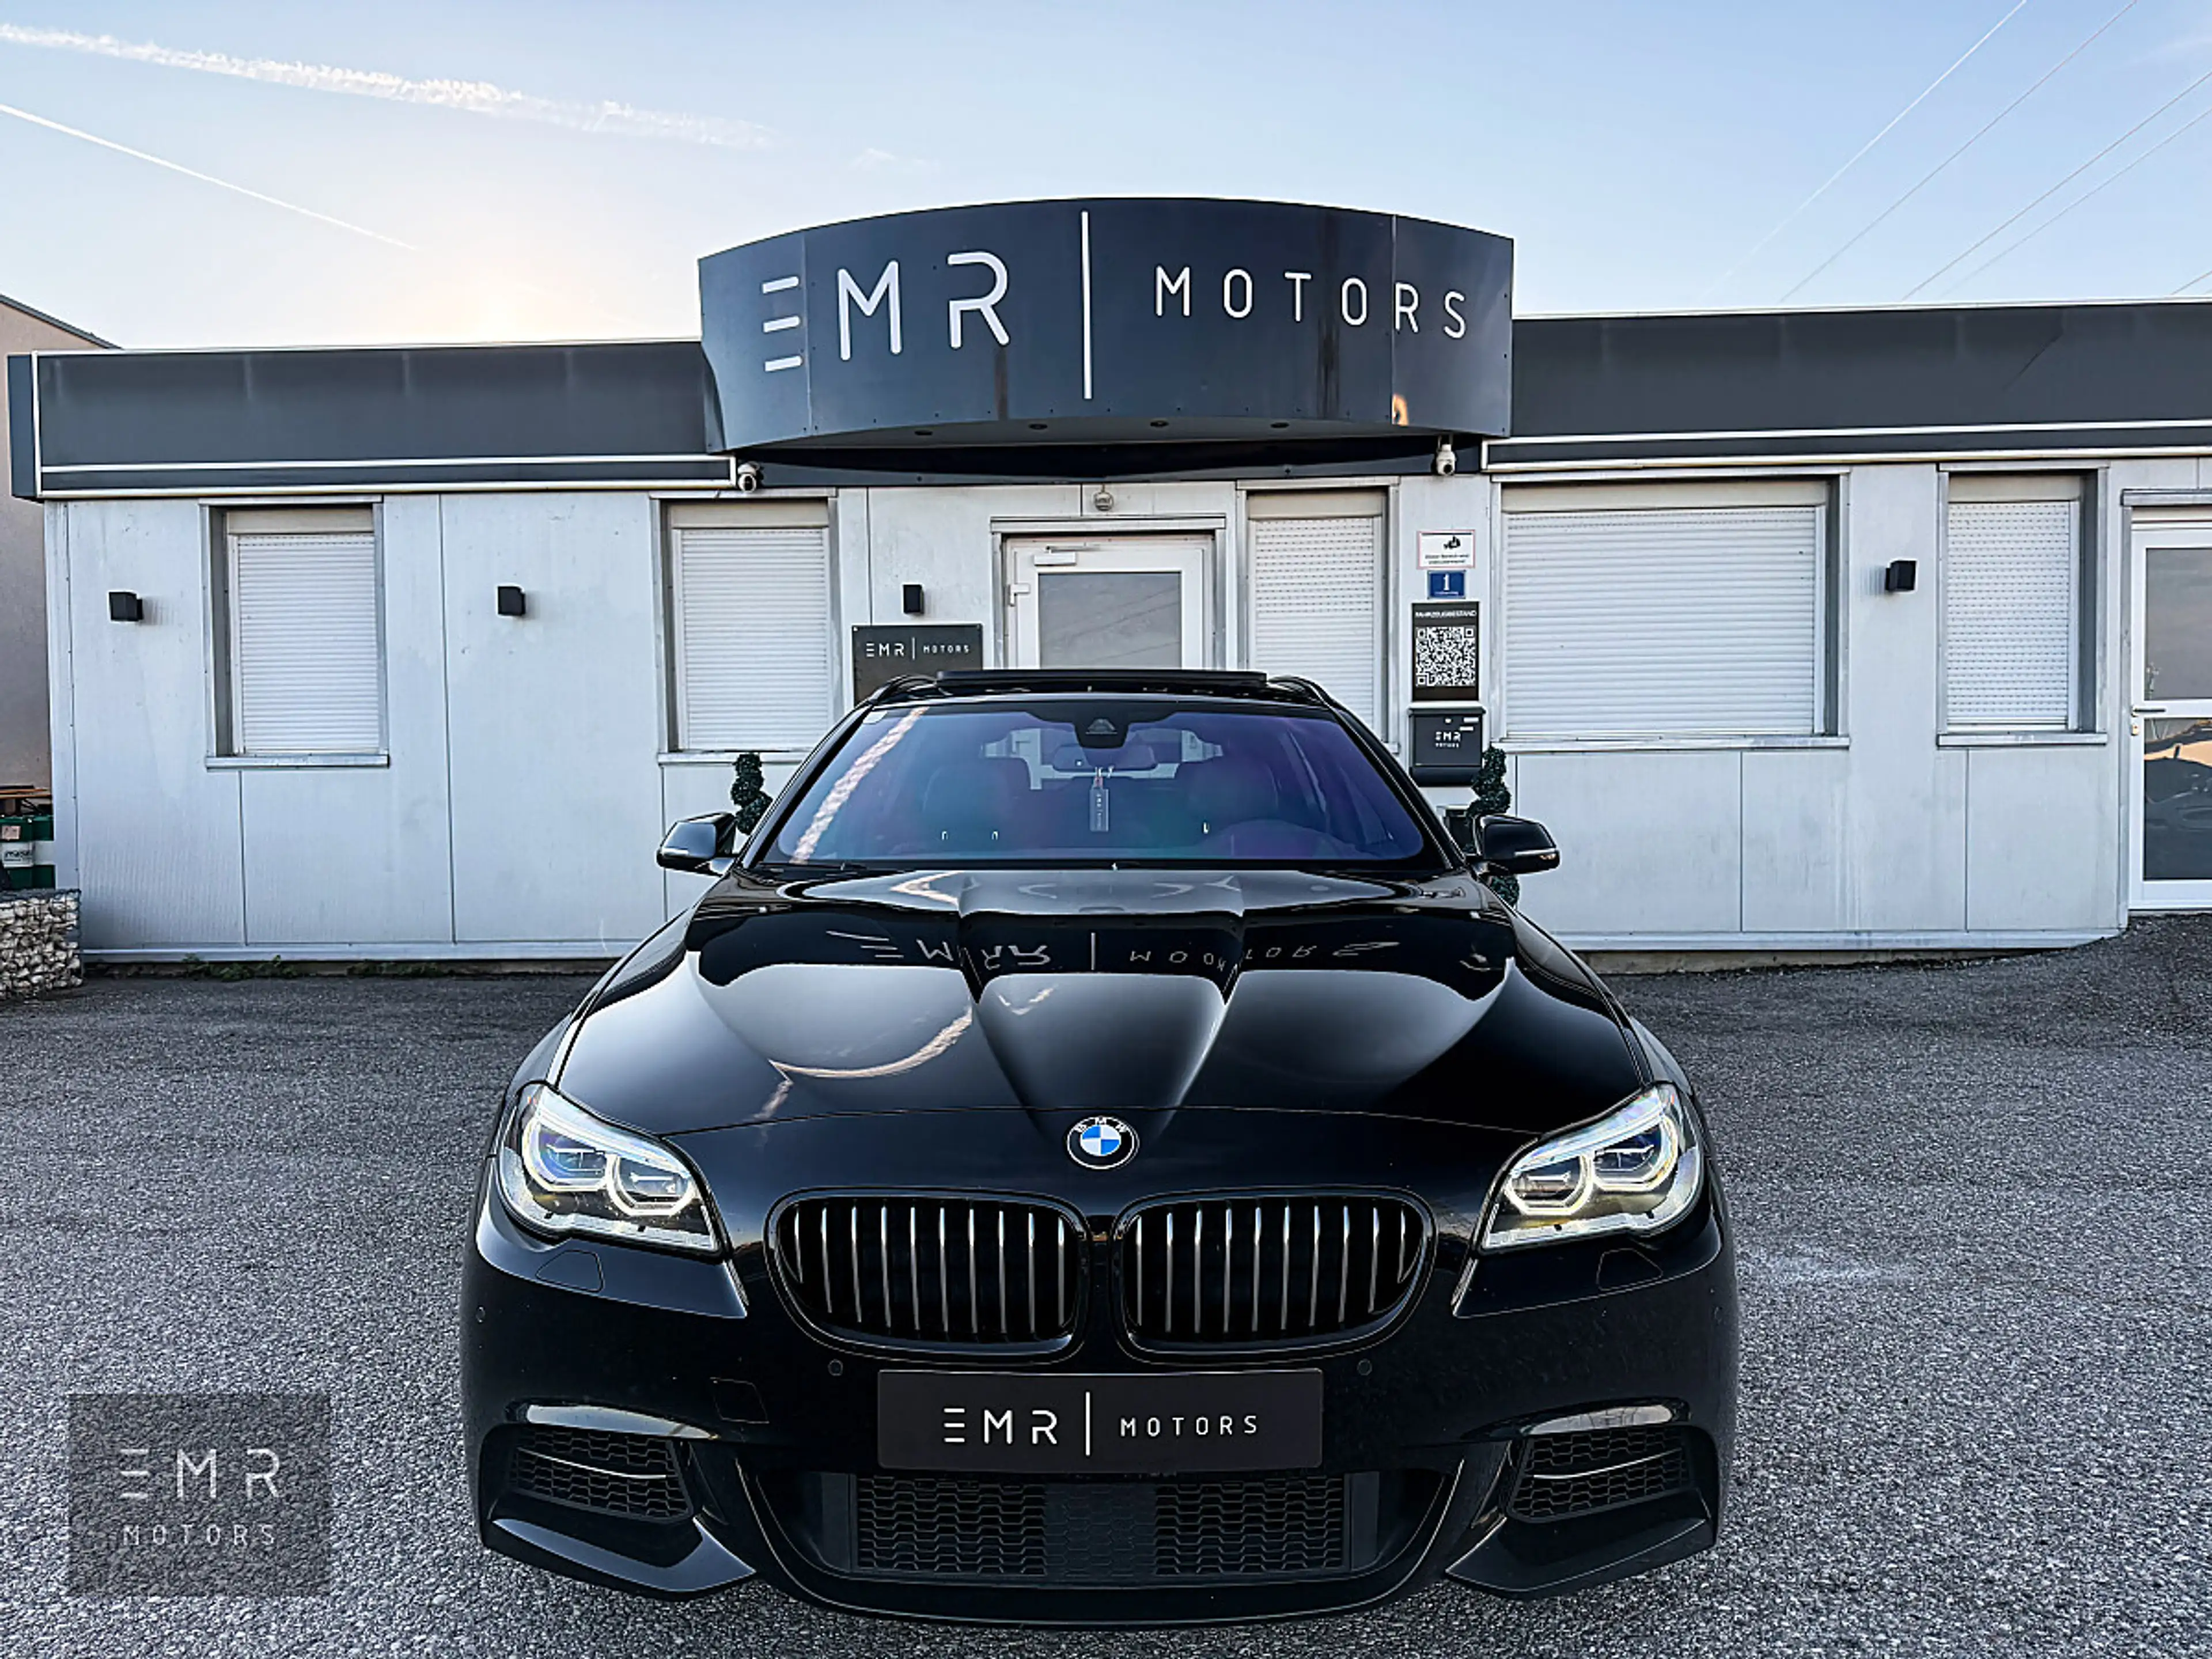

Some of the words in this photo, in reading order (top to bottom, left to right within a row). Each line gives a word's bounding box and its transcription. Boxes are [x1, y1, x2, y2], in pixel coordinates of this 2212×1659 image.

[762, 251, 1010, 372] EMR
[1155, 266, 1466, 339] MOTORS
[1443, 574, 1450, 591] 1
[866, 643, 904, 657] EMR
[923, 645, 969, 654] MOTORS
[944, 1407, 1058, 1445] EMR
[1120, 1415, 1257, 1437] MOTORS
